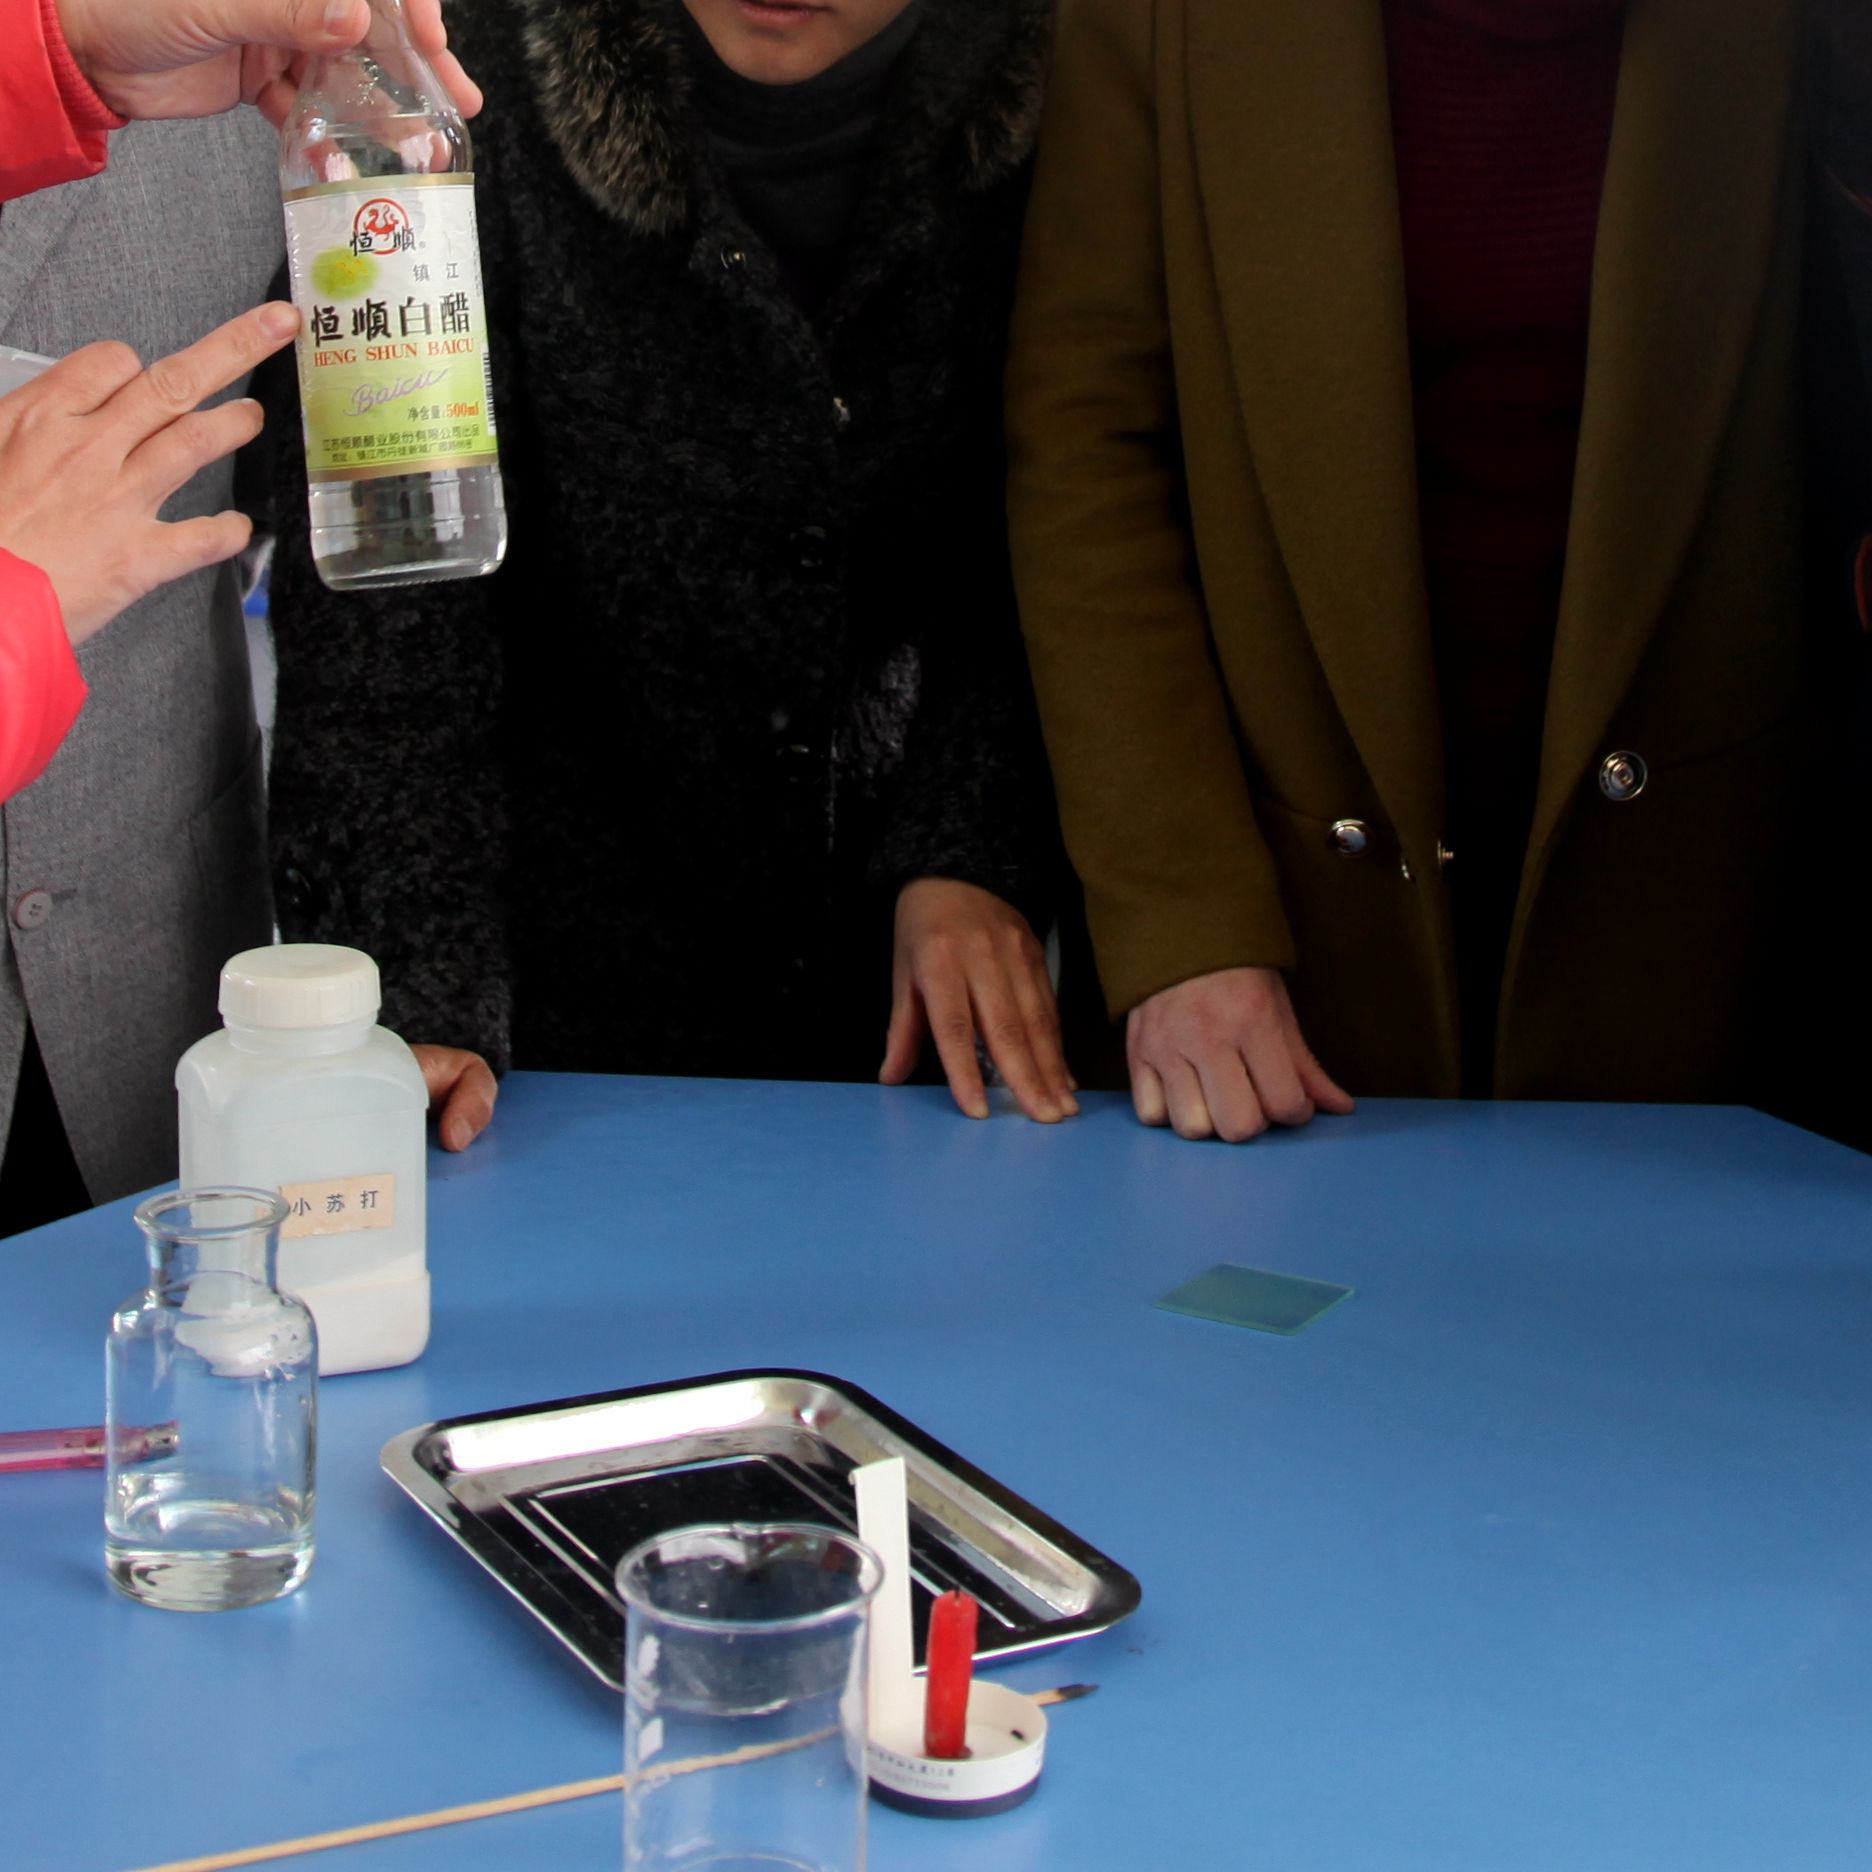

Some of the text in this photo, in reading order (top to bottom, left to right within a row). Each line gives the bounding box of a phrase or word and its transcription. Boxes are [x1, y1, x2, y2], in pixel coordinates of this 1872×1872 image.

[413, 263, 460, 282] 镇江
[314, 337, 474, 368] HENG SHUN BAICU
[342, 368, 449, 417] Baicu
[291, 1189, 379, 1216] 小苏打
